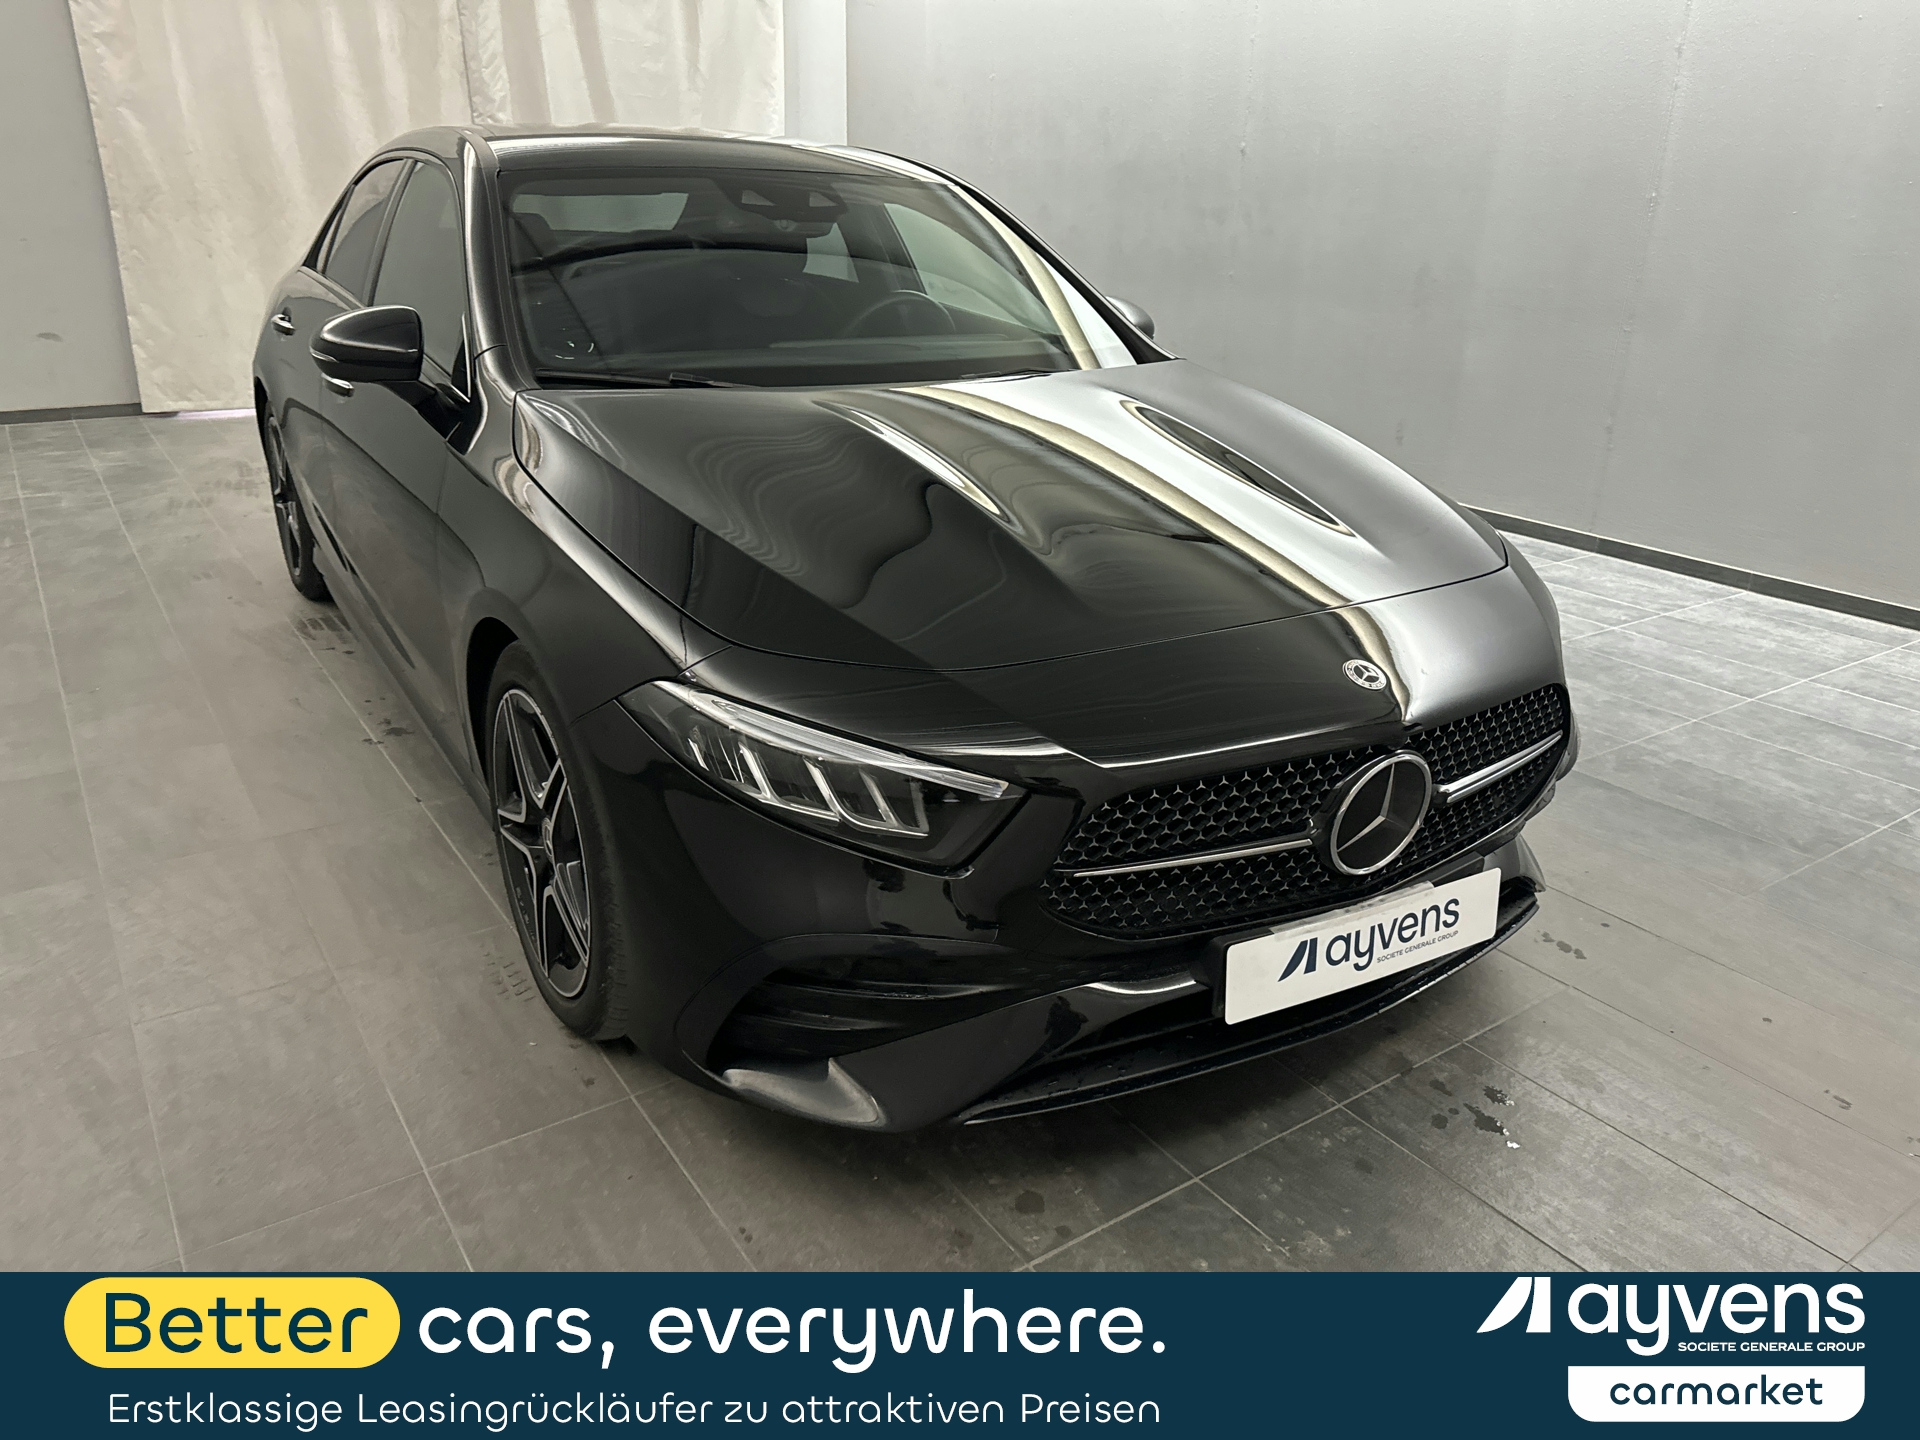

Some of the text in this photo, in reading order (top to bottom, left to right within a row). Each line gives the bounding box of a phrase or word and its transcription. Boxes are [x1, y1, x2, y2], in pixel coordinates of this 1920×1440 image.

[1325, 898, 1460, 971] ayvens
[1376, 930, 1459, 963] SOCIETE GENERALE GROUP
